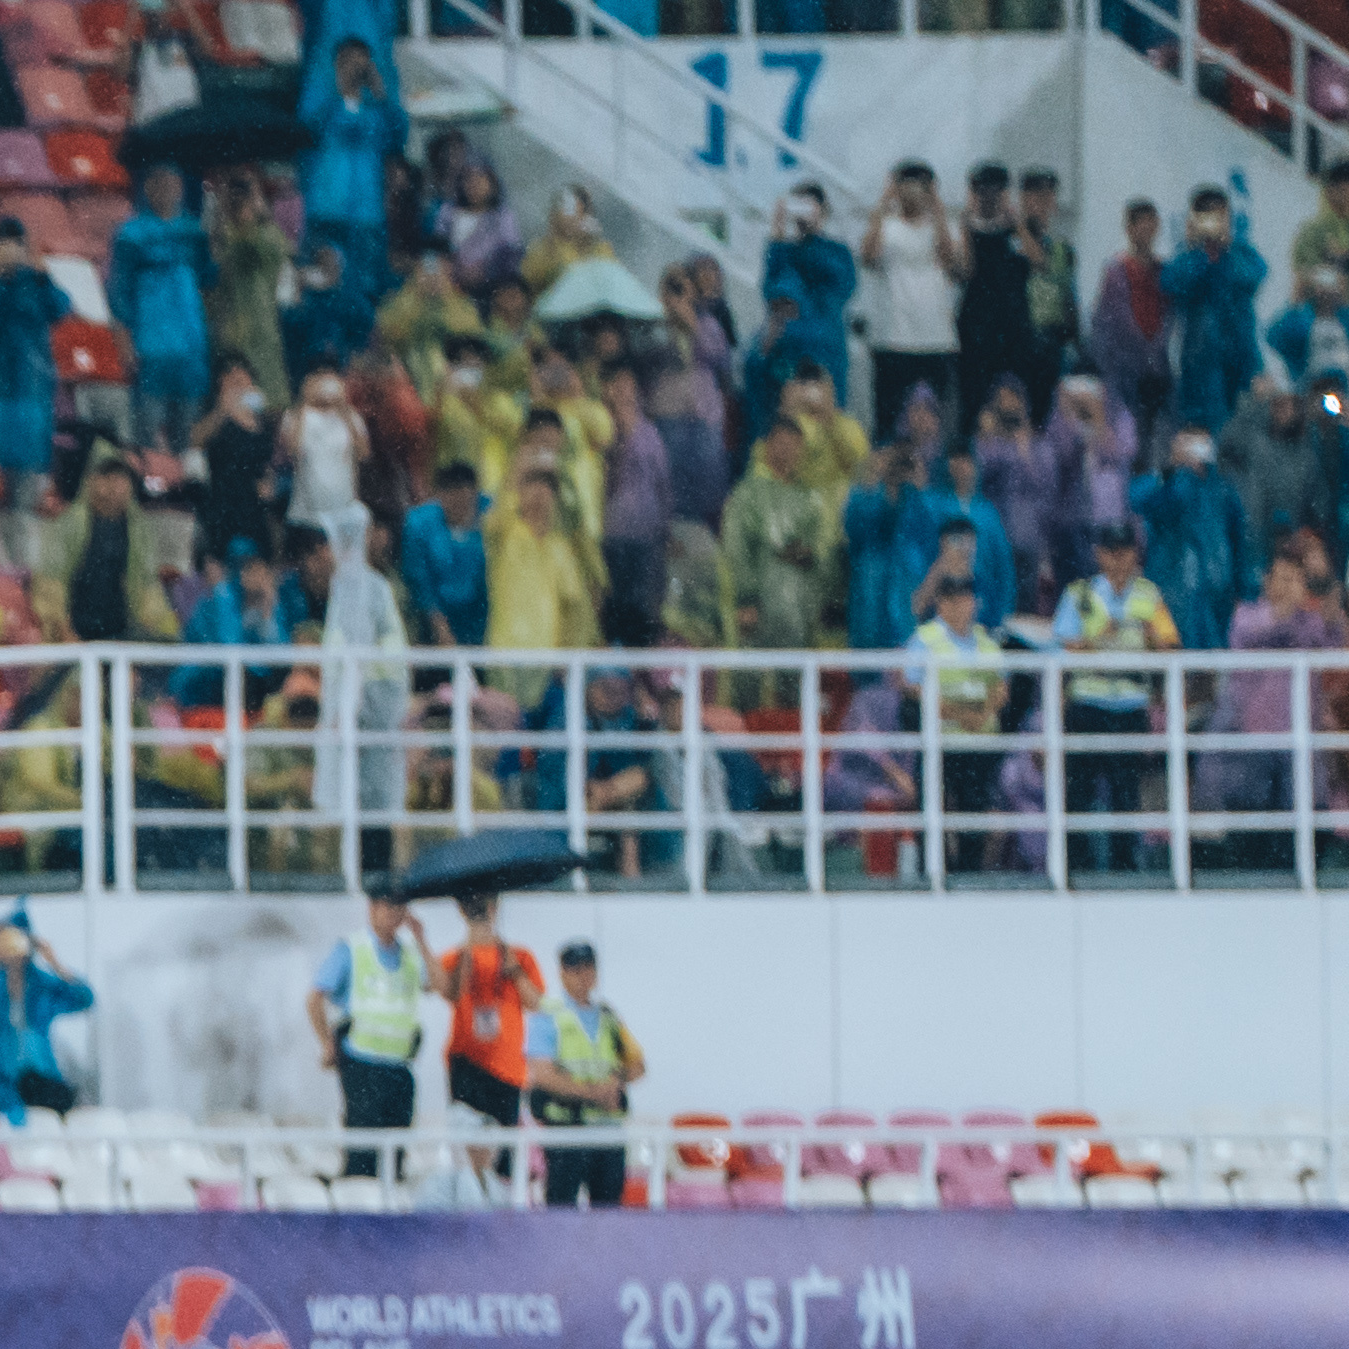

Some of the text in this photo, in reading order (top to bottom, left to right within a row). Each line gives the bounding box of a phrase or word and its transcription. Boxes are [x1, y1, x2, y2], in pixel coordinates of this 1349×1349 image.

[690, 50, 824, 168] 17
[306, 1292, 563, 1337] WORLD ATHLETICS
